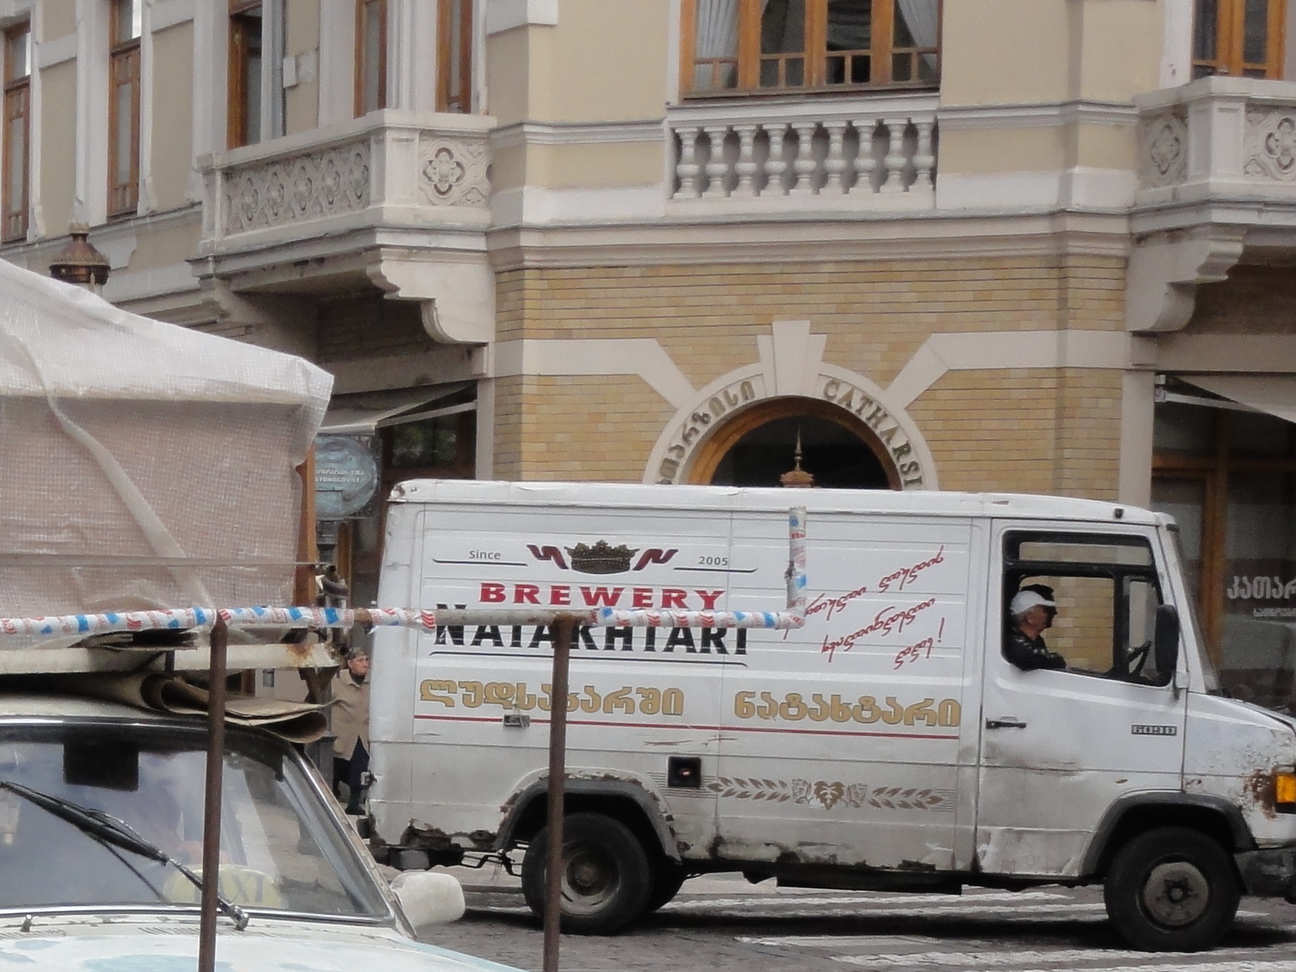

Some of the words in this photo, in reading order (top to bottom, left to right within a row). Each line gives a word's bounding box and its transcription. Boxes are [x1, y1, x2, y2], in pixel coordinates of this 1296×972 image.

[469, 549, 502, 561] Since
[698, 555, 729, 567] 2005
[479, 582, 726, 611] BREWERY
[420, 678, 685, 716] ლუდსახარში
[734, 690, 962, 727] ნატახტარი
